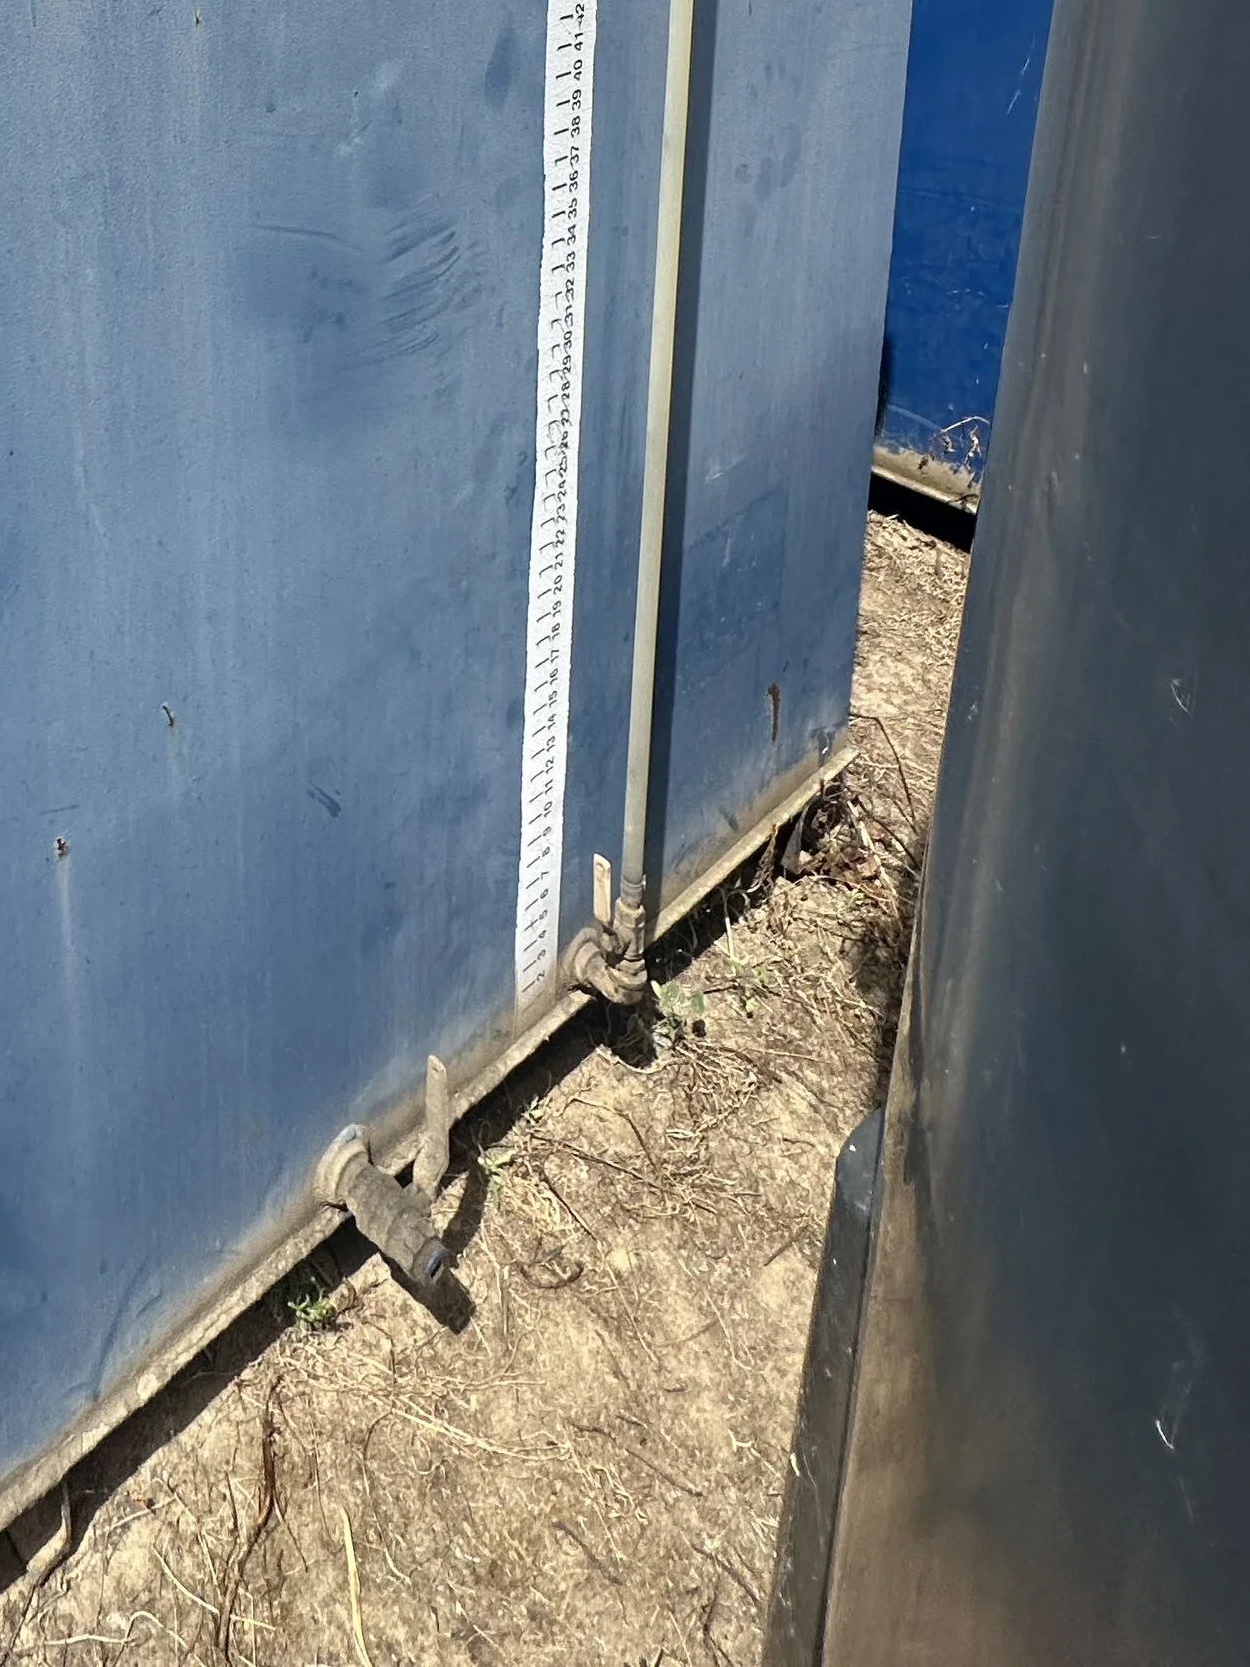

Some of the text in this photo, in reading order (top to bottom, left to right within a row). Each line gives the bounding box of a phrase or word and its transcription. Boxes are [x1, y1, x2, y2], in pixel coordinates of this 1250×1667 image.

[574, 3, 585, 26] 42
[574, 32, 584, 51] 41
[573, 59, 582, 81] 40
[572, 89, 582, 111] 39
[571, 116, 580, 138] 38
[570, 146, 580, 164] 37
[569, 170, 578, 192] 36
[568, 198, 578, 220] 35
[567, 224, 576, 245] 34
[566, 250, 576, 273] 33
[565, 277, 574, 302] 32
[564, 304, 573, 327] 31
[564, 330, 572, 348] 30
[563, 355, 571, 373] 29
[562, 380, 570, 400] 28
[557, 480, 566, 501] 24
[556, 503, 566, 523] 23
[555, 528, 565, 547] 22
[554, 552, 563, 570] 21
[553, 574, 562, 595] 20
[552, 600, 562, 617] 19
[552, 623, 560, 640] 18
[550, 649, 560, 664] 17
[550, 668, 559, 685] 16
[549, 690, 558, 708] 15
[548, 714, 556, 730] 14
[546, 736, 556, 752] 13
[546, 756, 555, 774] 12
[545, 779, 554, 795] 11
[544, 800, 553, 818] 10
[542, 826, 552, 836] 9
[542, 846, 550, 858] 8
[540, 871, 549, 879] 7
[539, 889, 548, 899] 6
[538, 910, 547, 920] 5
[538, 930, 547, 938] 4
[537, 950, 546, 960] 3
[535, 970, 545, 981] 2
